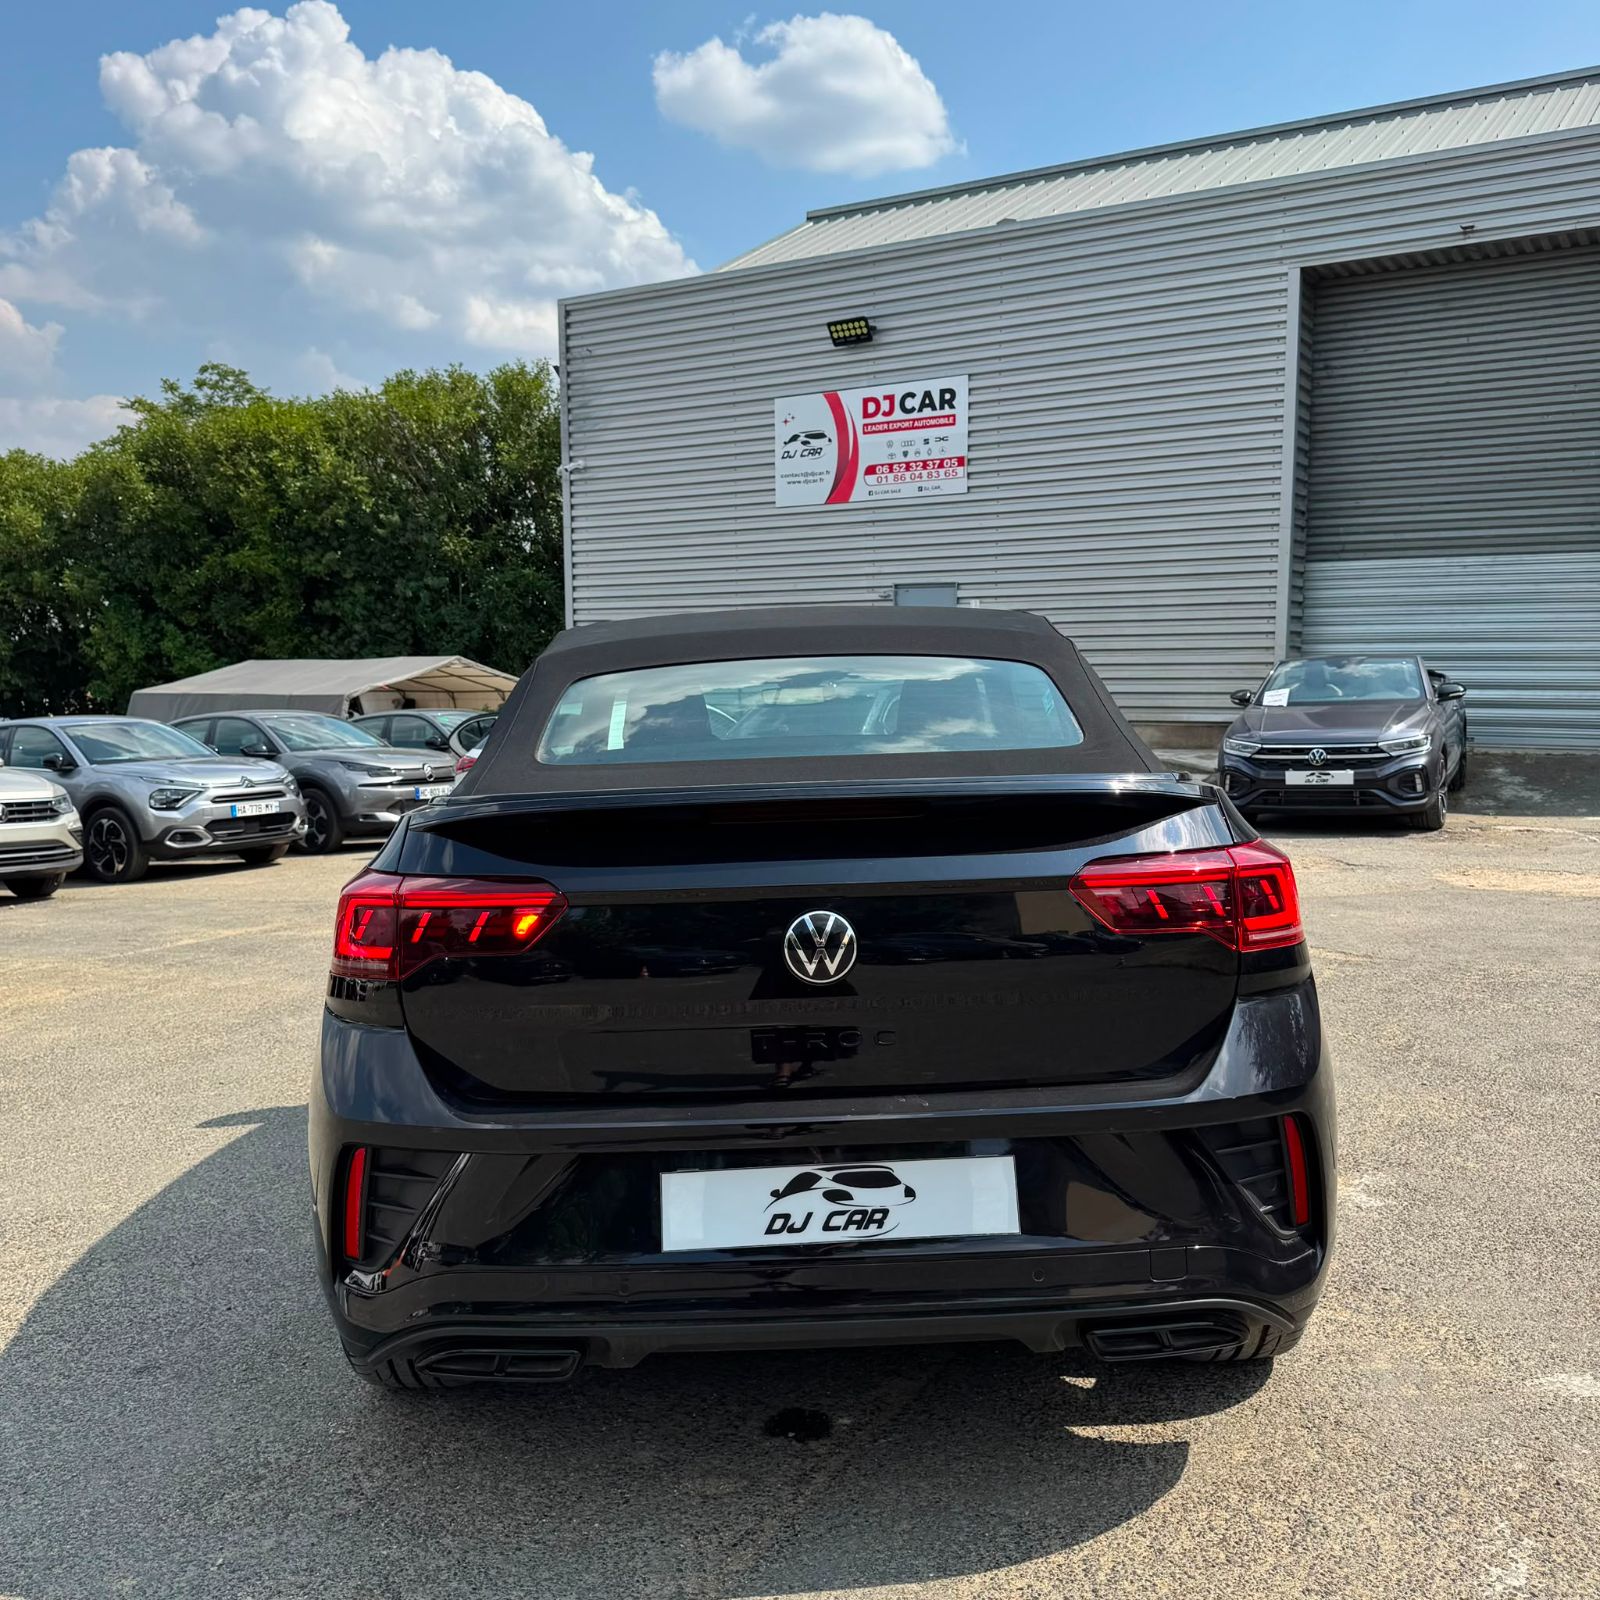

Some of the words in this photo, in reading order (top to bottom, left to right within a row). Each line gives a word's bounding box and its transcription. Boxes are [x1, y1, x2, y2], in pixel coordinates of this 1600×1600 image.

[899, 387, 957, 415] CAR
[864, 422, 889, 433] LEADER
[889, 420, 913, 430] EXPORT
[913, 416, 955, 427] AUTOMOBILE
[781, 449, 798, 460] DJ
[800, 447, 823, 457] CAR
[876, 465, 889, 474] 06
[893, 463, 906, 472] 52
[909, 462, 923, 471] 32
[926, 460, 941, 469] 37
[943, 458, 958, 467] 05
[876, 475, 889, 484] 01
[893, 473, 906, 482] 86
[909, 472, 923, 481] 04
[926, 470, 940, 479] 83
[944, 468, 958, 477] 65
[764, 1212, 813, 1235] DJ
[822, 1208, 890, 1232] CAR
